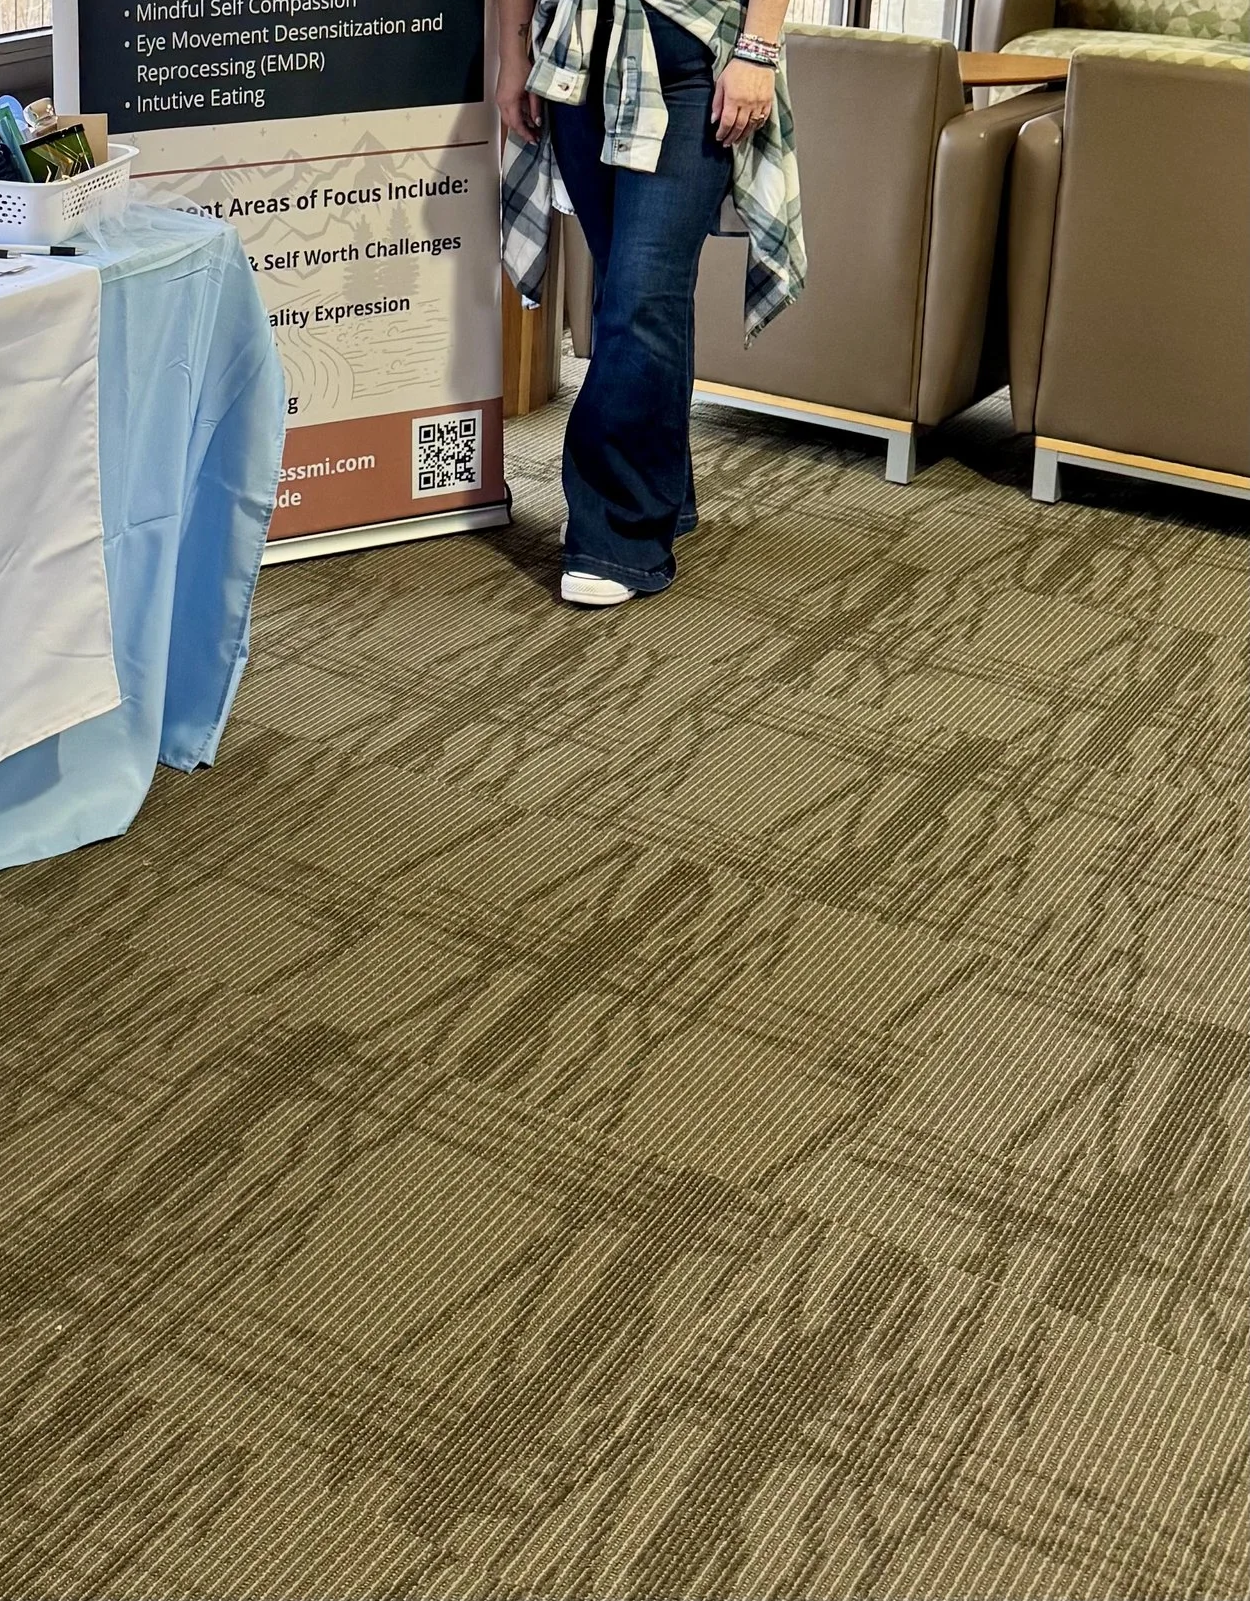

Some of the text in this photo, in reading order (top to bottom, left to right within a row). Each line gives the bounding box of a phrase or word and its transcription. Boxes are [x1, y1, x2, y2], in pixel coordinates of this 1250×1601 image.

[137, 14, 443, 57] Eye Movement Desensitization and
[137, 52, 325, 85] Reprocessing (EMDR)
[137, 87, 265, 113] Intutive Eating
[229, 196, 290, 218] Areas
[296, 190, 318, 209] of
[323, 186, 381, 207] Focus
[388, 177, 469, 200] Include:
[264, 251, 299, 271] Self
[304, 244, 359, 266] Worth
[365, 234, 461, 261] Challenges
[269, 297, 410, 330] ality Expression
[277, 452, 375, 481] essmi.com
